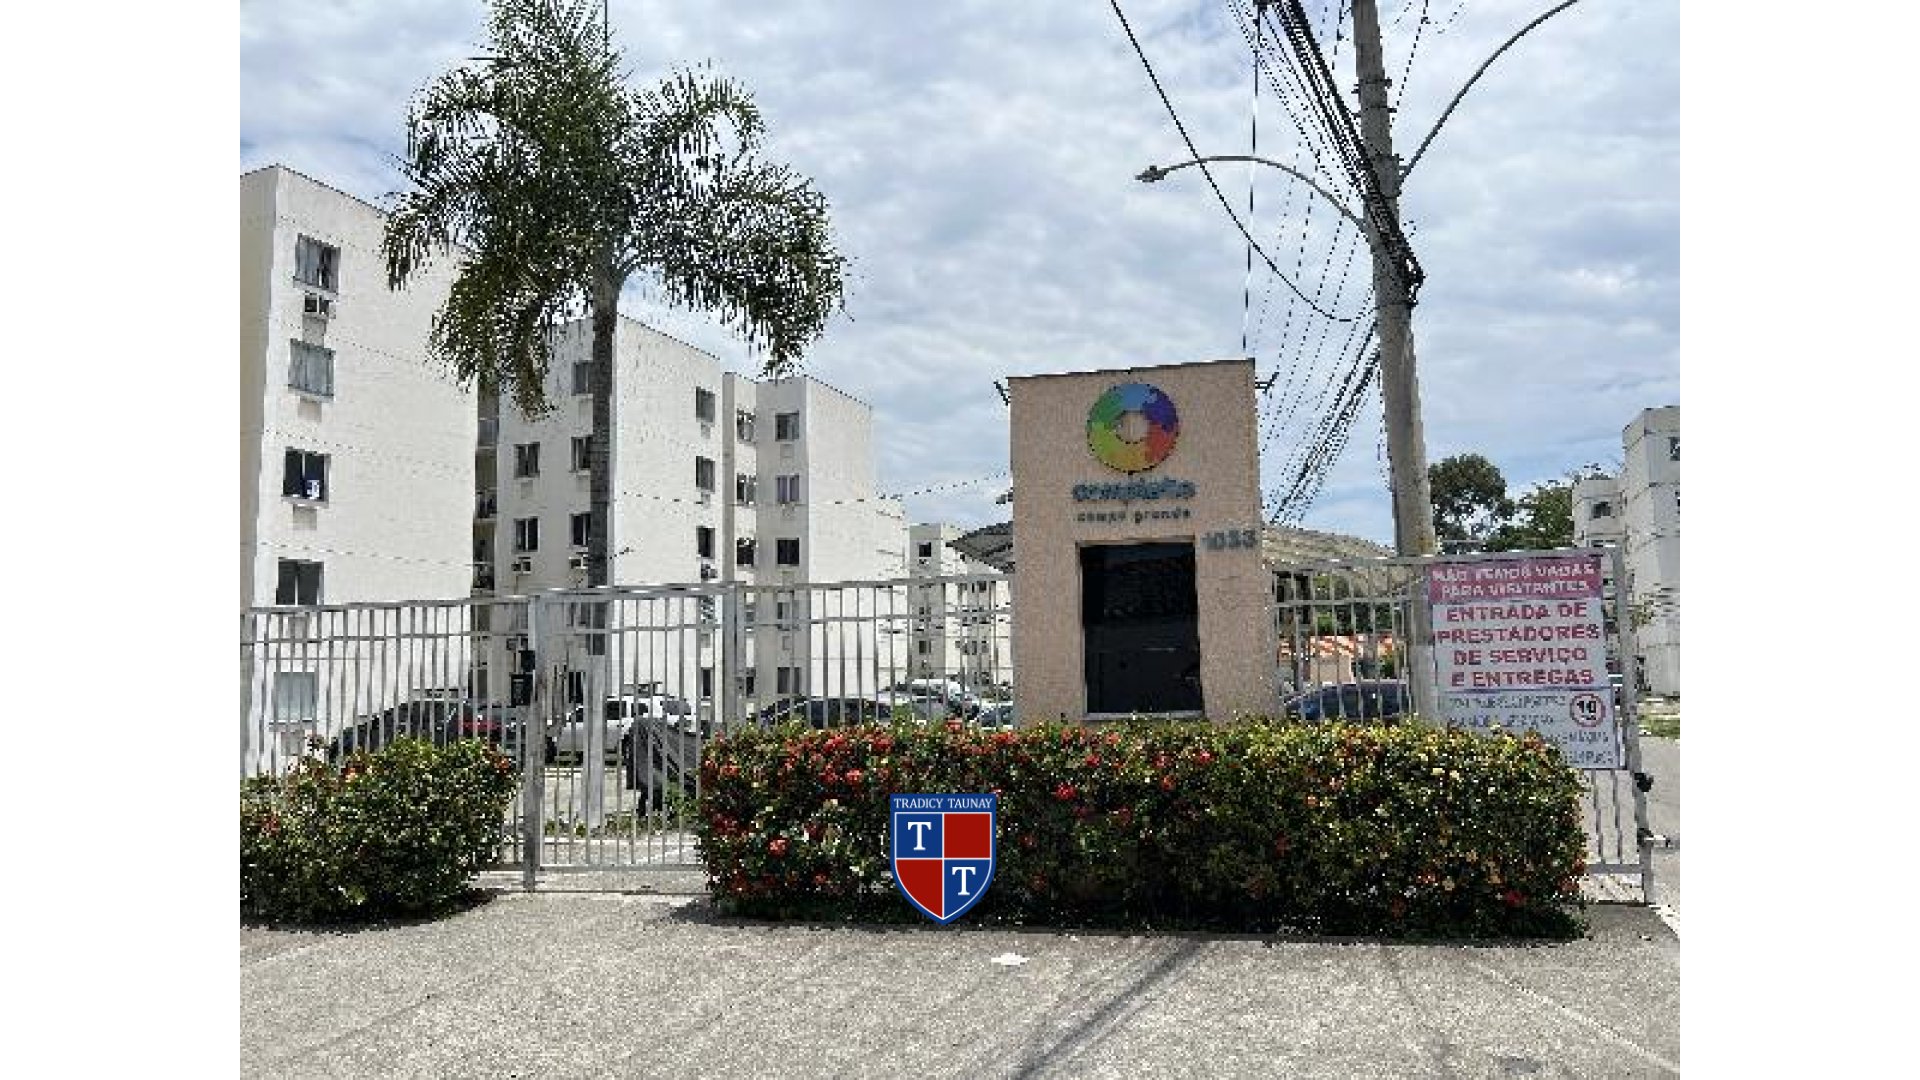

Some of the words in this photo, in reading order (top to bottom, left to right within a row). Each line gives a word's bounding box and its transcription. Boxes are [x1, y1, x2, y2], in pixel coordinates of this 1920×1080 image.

[1134, 507, 1191, 524] grande
[1475, 566, 1532, 581] TEMOS
[1535, 563, 1594, 577] VAGAS
[1442, 584, 1483, 597] PARA
[1487, 580, 1590, 596] VISITANTES
[1447, 604, 1550, 622] ENTRADA
[1557, 602, 1587, 618] DE
[1437, 624, 1599, 643] PRESTADORES
[1454, 649, 1481, 665] DE
[1490, 647, 1587, 665] SERVIÇO
[1451, 671, 1465, 687] E
[1473, 669, 1594, 687] ENTREGAS
